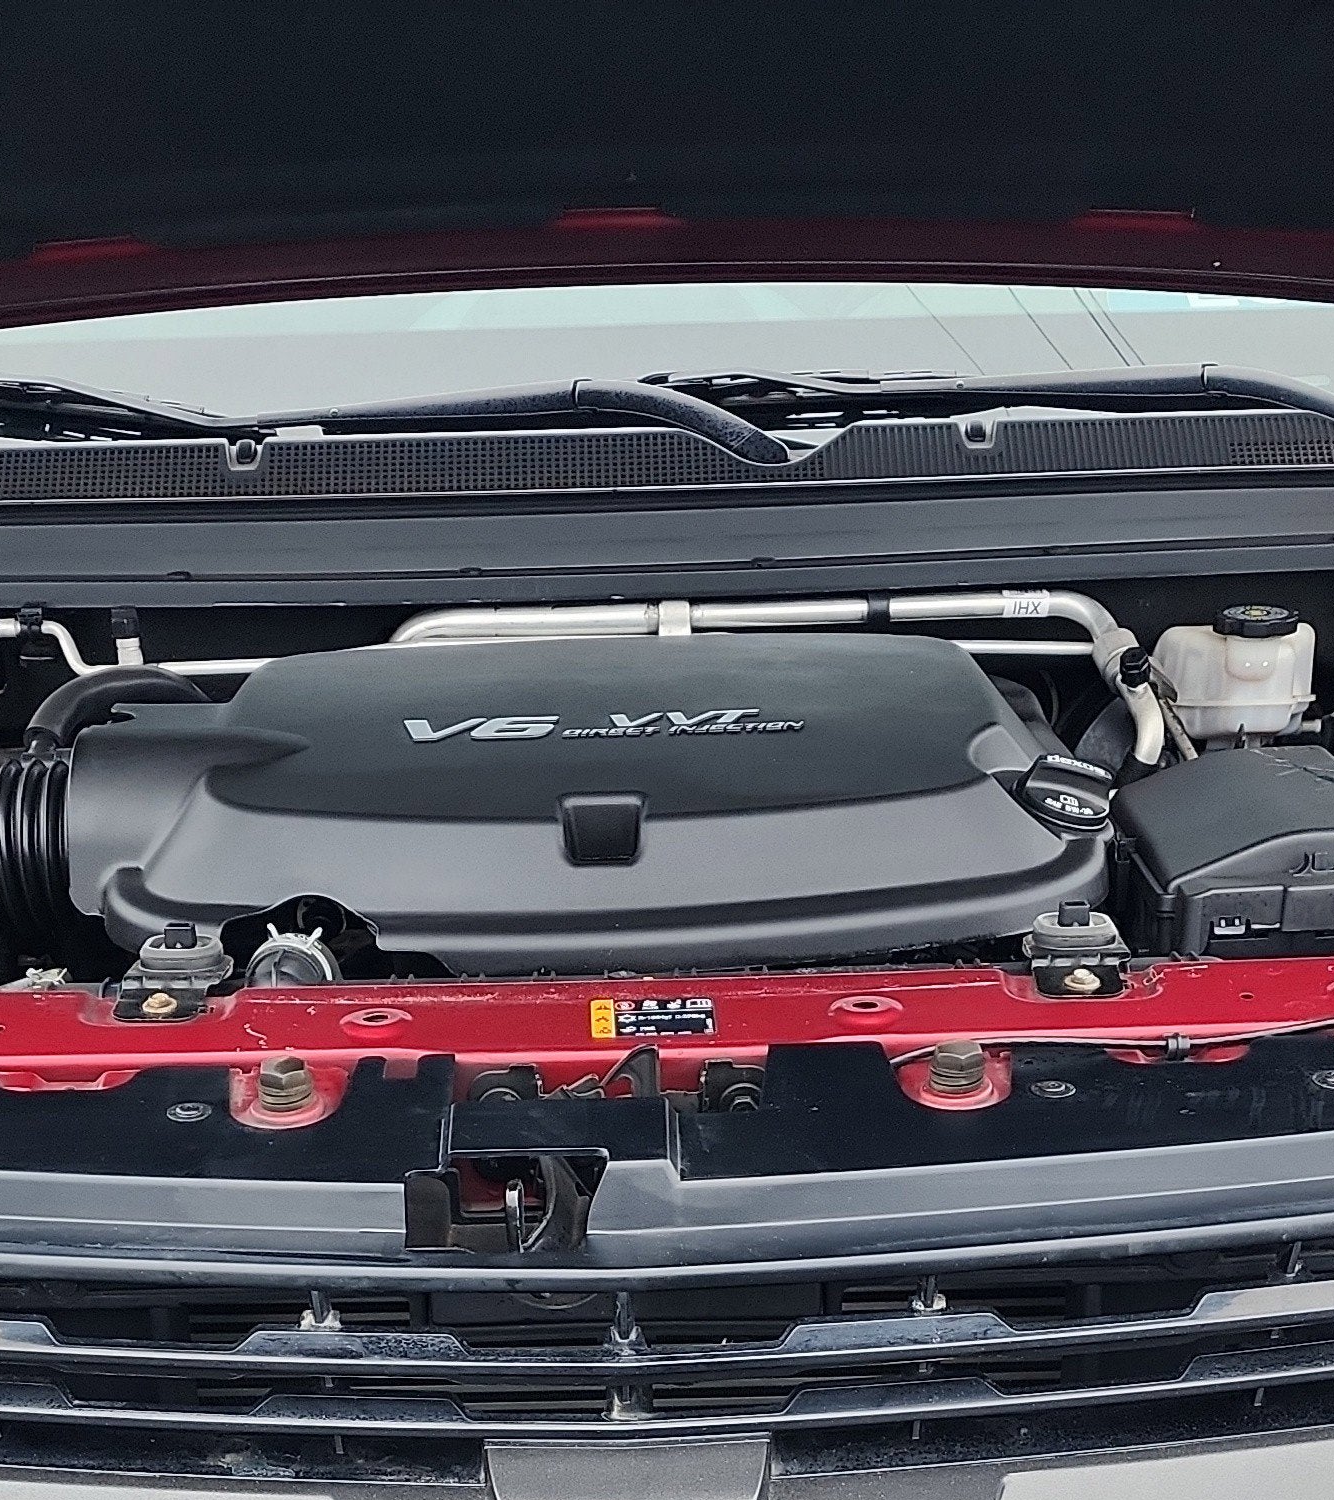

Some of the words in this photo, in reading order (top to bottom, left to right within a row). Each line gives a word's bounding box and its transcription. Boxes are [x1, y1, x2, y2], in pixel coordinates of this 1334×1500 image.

[1012, 600, 1042, 615] IHX
[609, 708, 761, 728] VVT
[403, 715, 561, 742] V6
[562, 726, 662, 738] DIRECT
[667, 720, 805, 735] INJECTION
